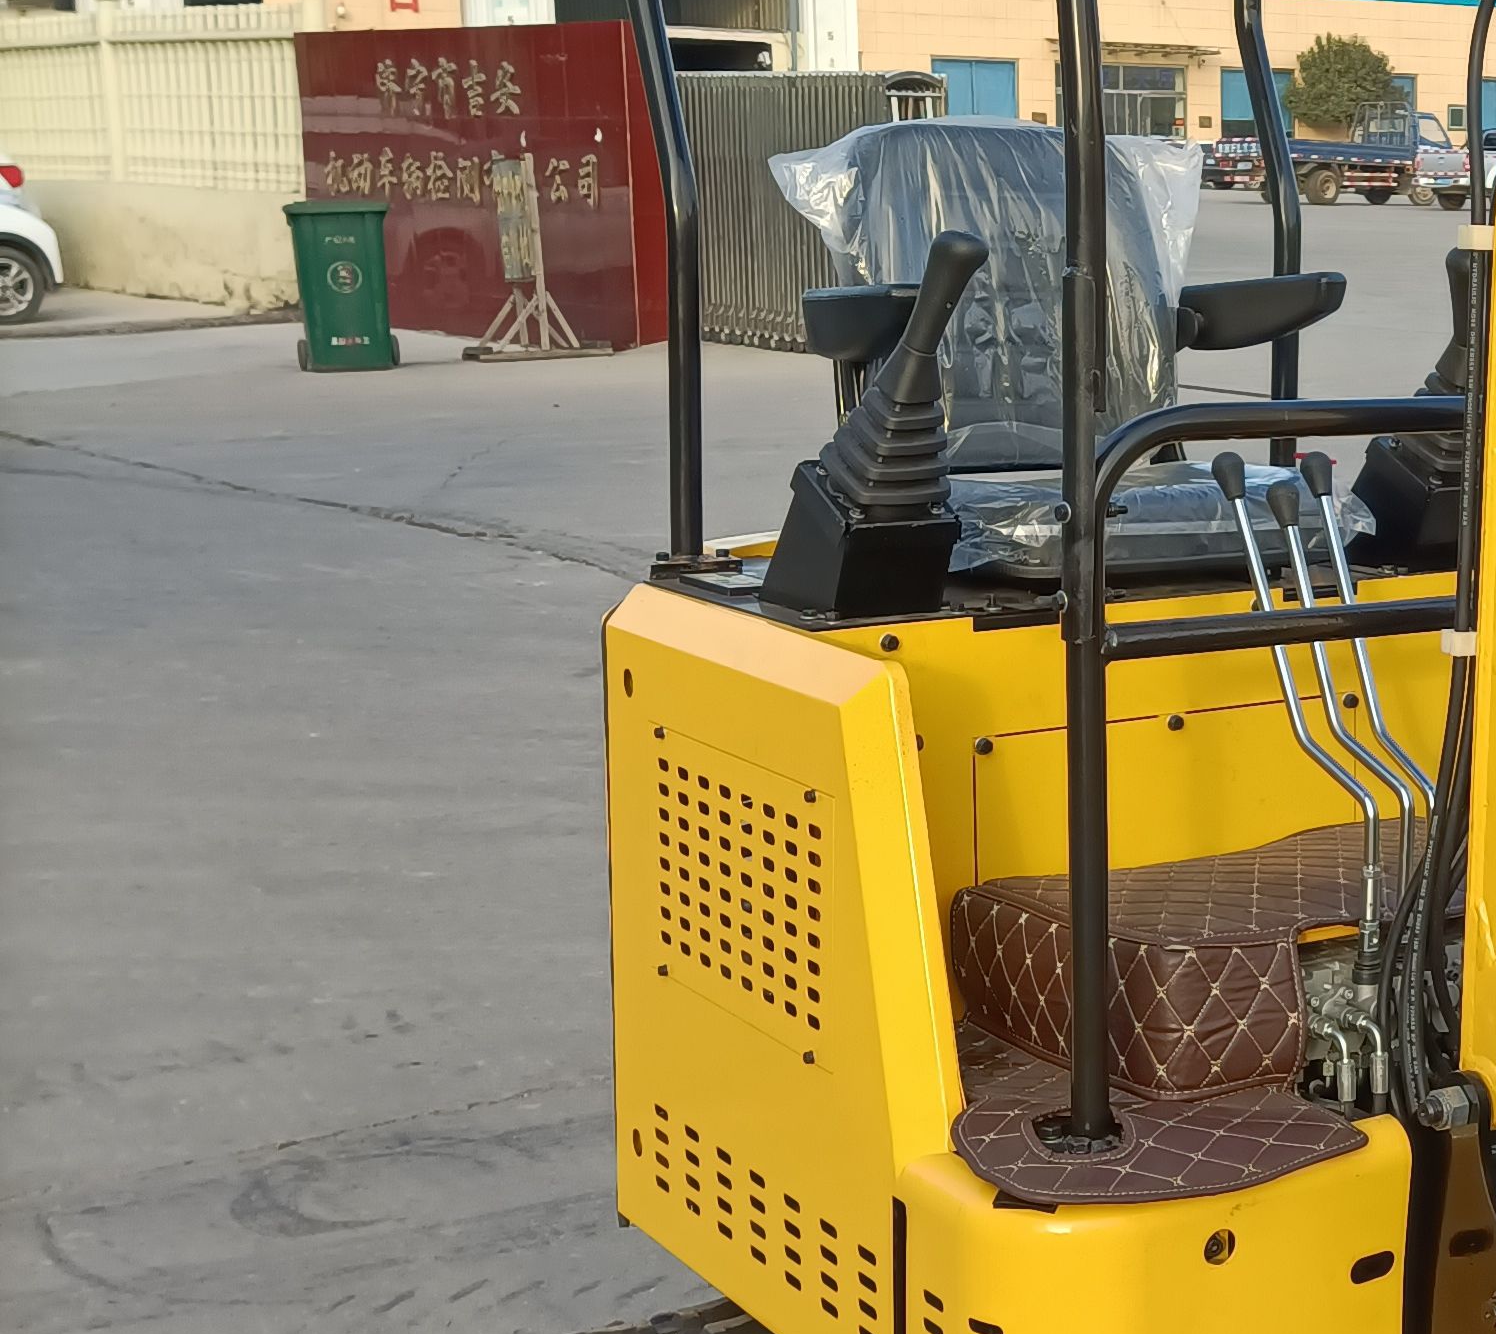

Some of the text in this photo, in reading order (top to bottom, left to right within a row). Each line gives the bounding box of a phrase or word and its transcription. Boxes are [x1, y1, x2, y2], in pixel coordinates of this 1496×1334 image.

[324, 147, 598, 209] 机动车辆检测公司
